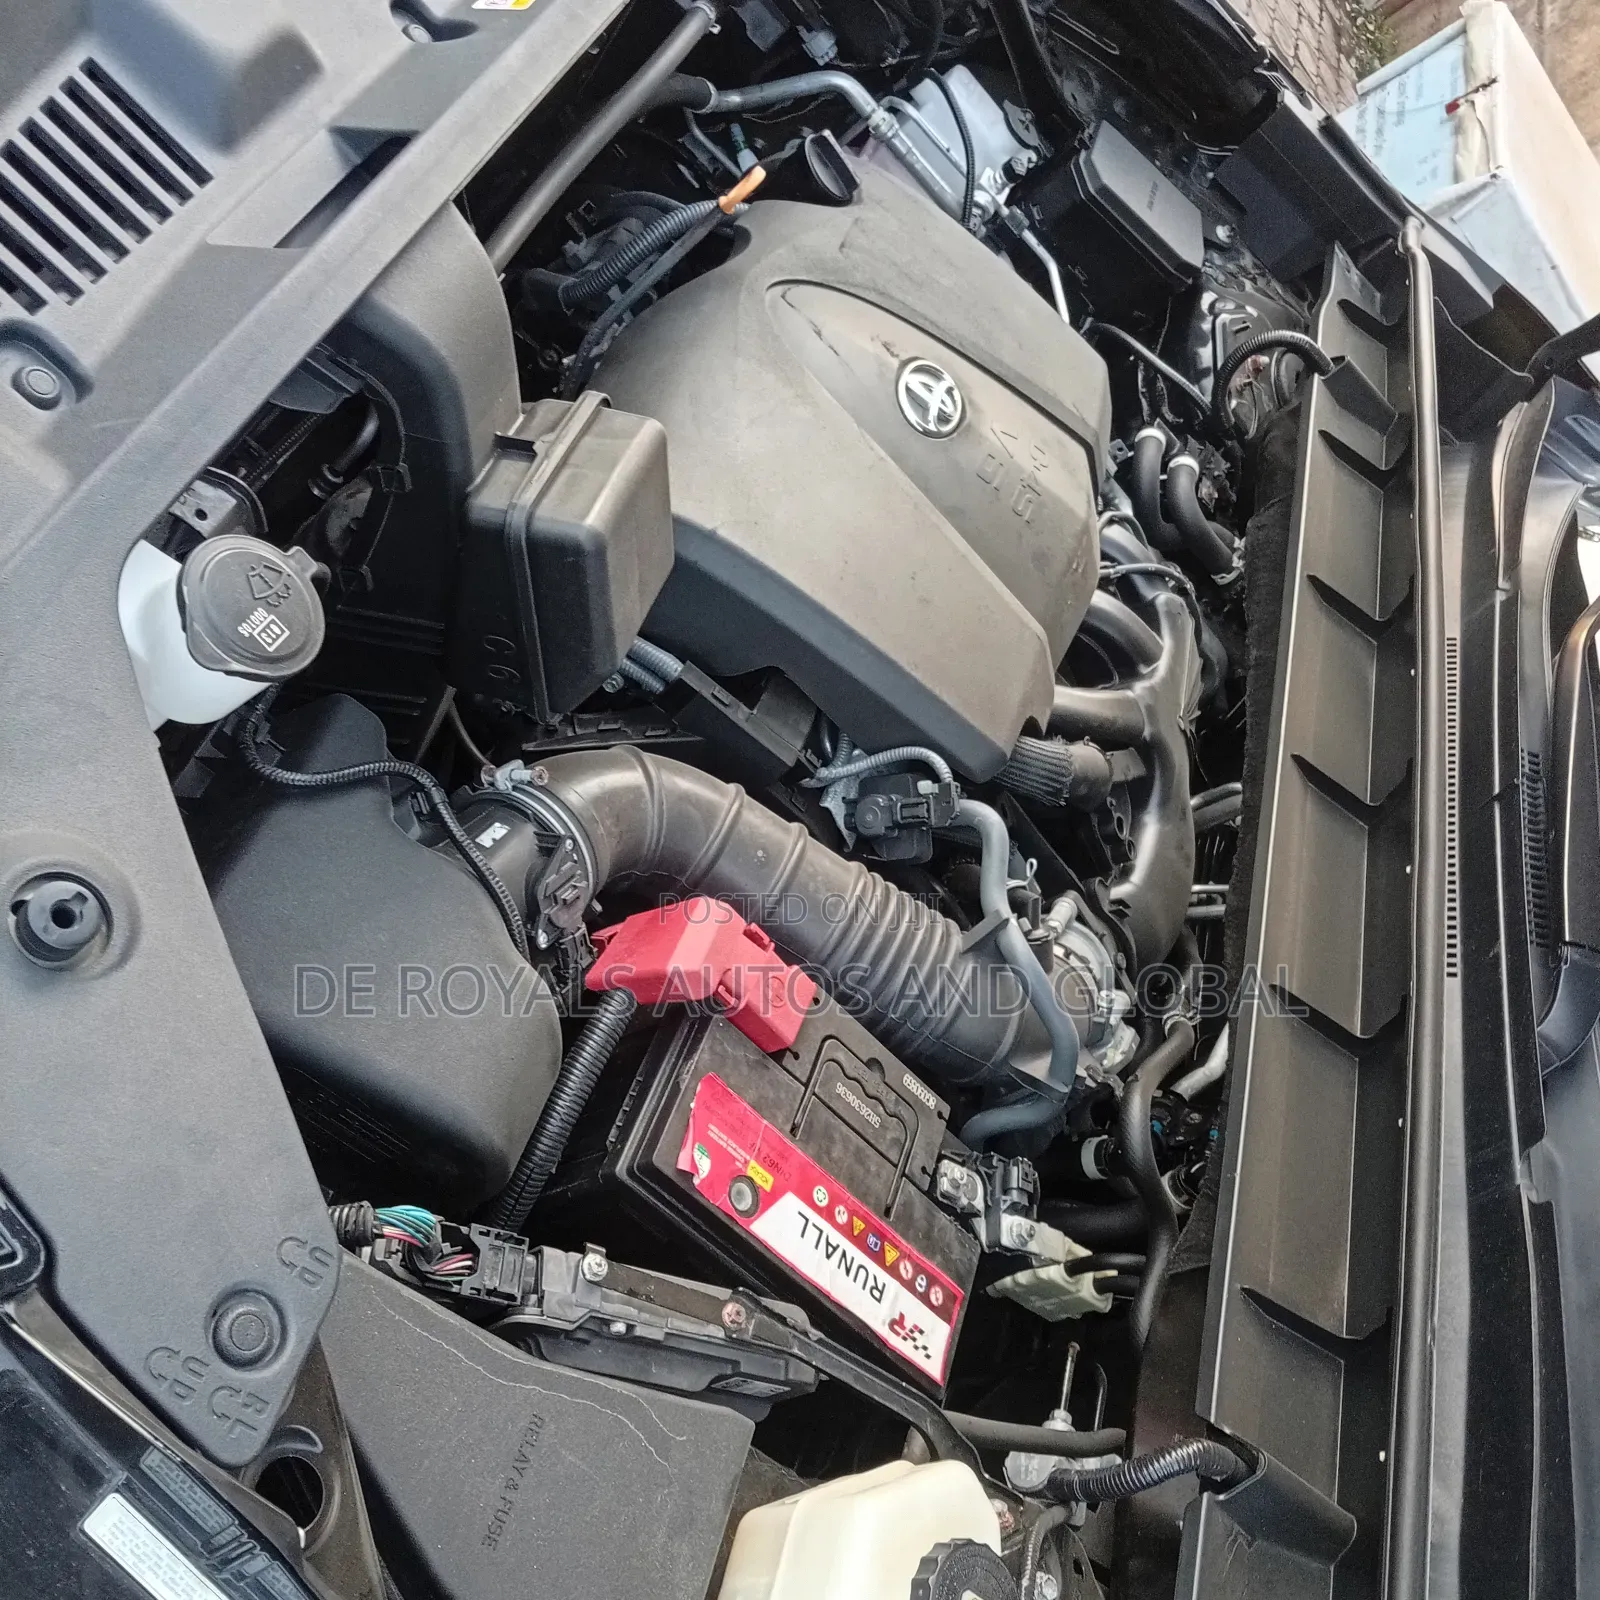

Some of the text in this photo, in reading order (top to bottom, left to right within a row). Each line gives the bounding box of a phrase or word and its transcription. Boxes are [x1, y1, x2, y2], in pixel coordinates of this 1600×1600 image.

[835, 1082, 881, 1129] 5H2630636
[798, 1211, 886, 1304] RUNALL
[512, 1413, 544, 1478] RELAY
[481, 1495, 514, 1551] FUSE
